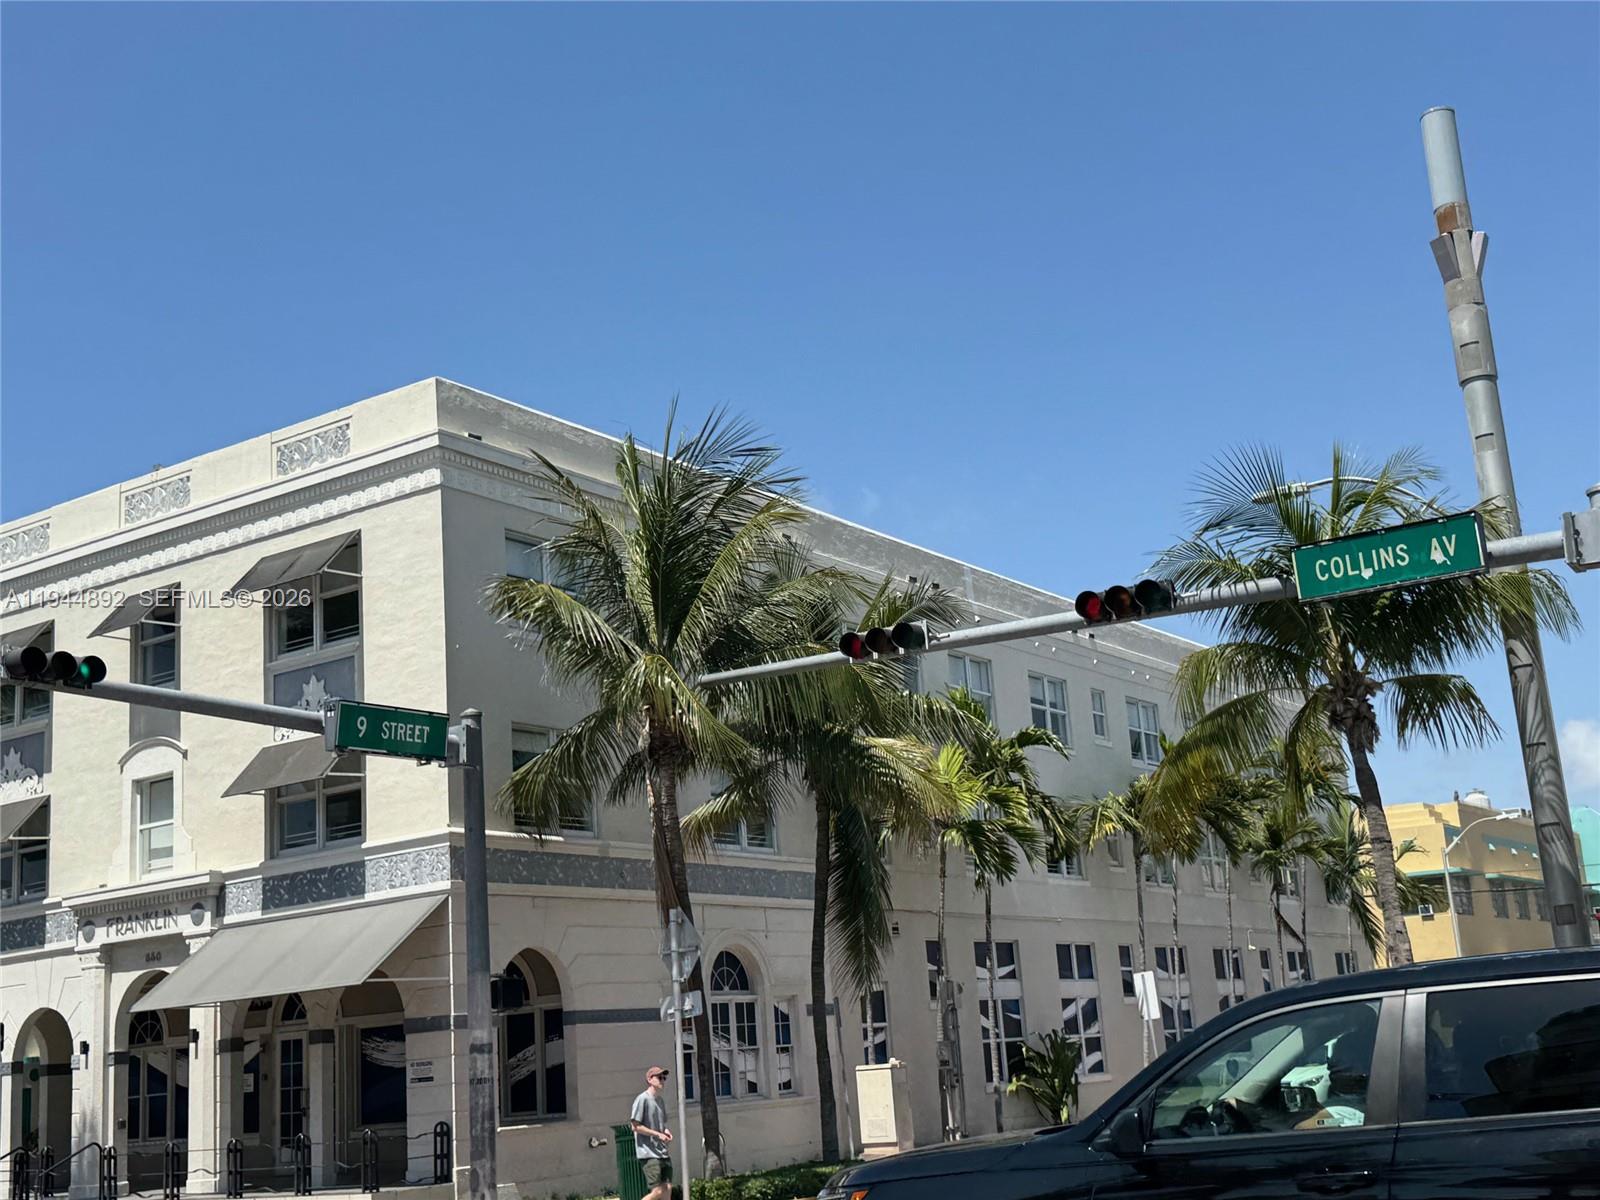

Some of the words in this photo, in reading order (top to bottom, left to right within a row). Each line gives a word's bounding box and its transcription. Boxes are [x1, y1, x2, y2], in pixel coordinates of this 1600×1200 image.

[1315, 544, 1410, 581] COLLINS
[1430, 534, 1457, 561] AV
[357, 716, 367, 738] 9
[381, 721, 430, 743] STREET
[106, 907, 178, 938] FRANKLIN
